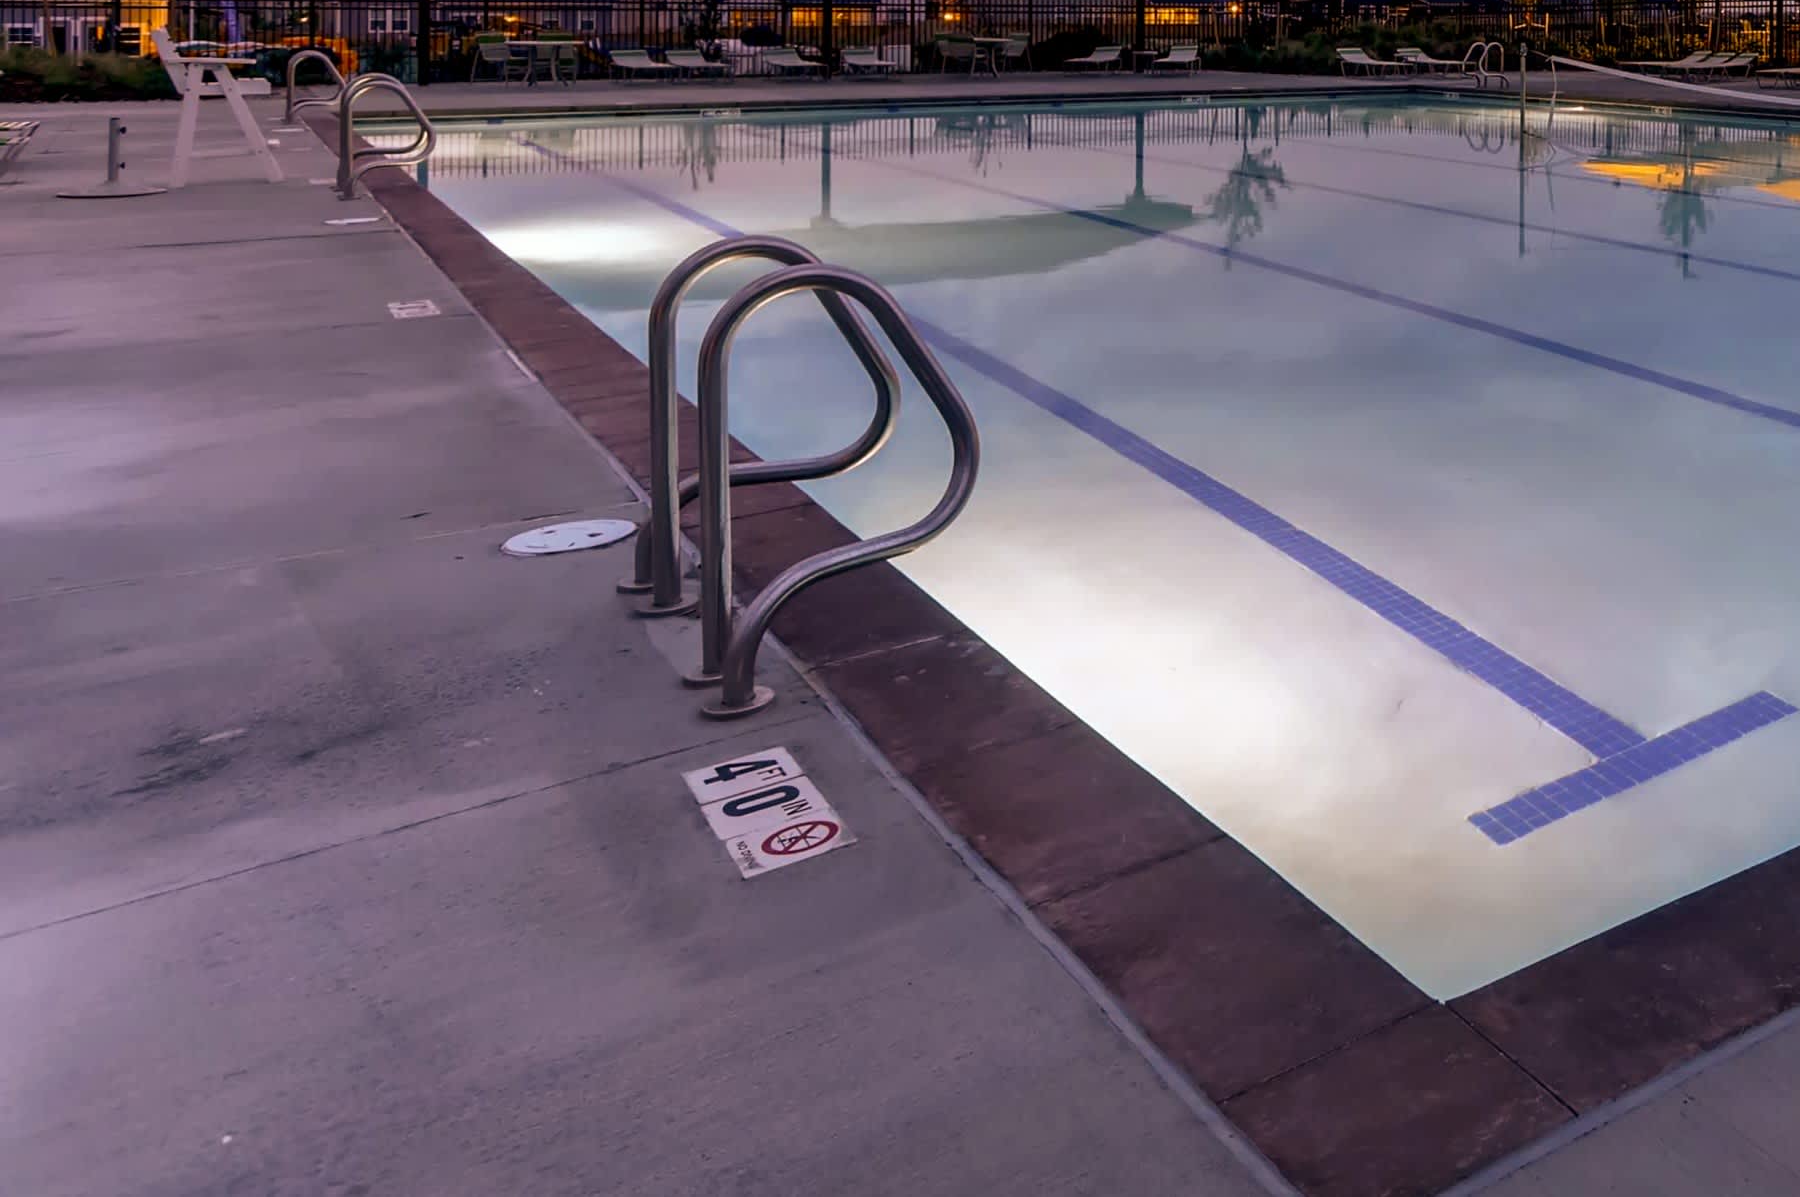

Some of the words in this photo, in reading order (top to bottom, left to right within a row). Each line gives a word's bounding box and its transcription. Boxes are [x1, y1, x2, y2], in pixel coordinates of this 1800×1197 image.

[703, 759, 778, 785] 4
[756, 766, 787, 781] FT
[722, 785, 800, 817] 0
[780, 799, 813, 816] IN
